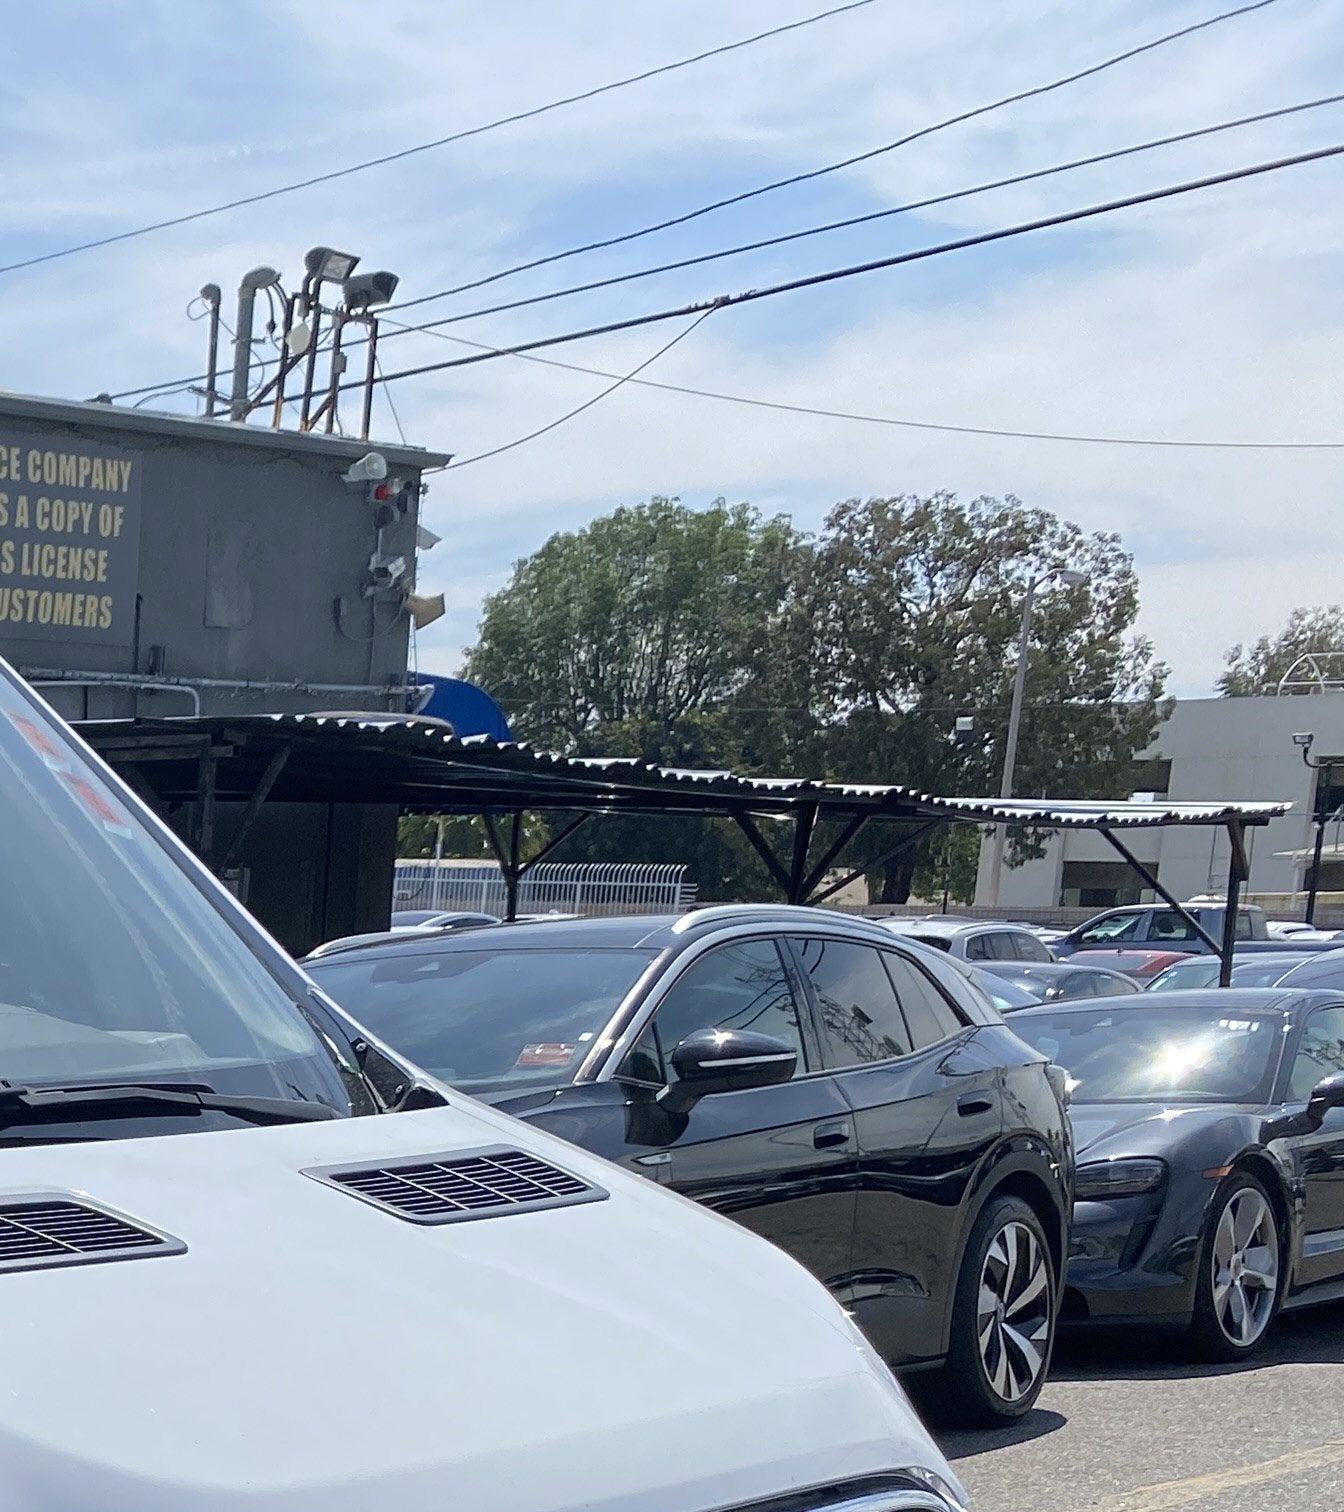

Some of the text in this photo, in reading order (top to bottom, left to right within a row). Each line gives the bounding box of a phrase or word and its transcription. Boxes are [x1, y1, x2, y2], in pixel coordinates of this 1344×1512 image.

[27, 449, 132, 493] COMPANY
[15, 495, 29, 529] A
[36, 498, 94, 536] COPY
[99, 503, 124, 537] OF
[21, 543, 108, 583] LICENSE
